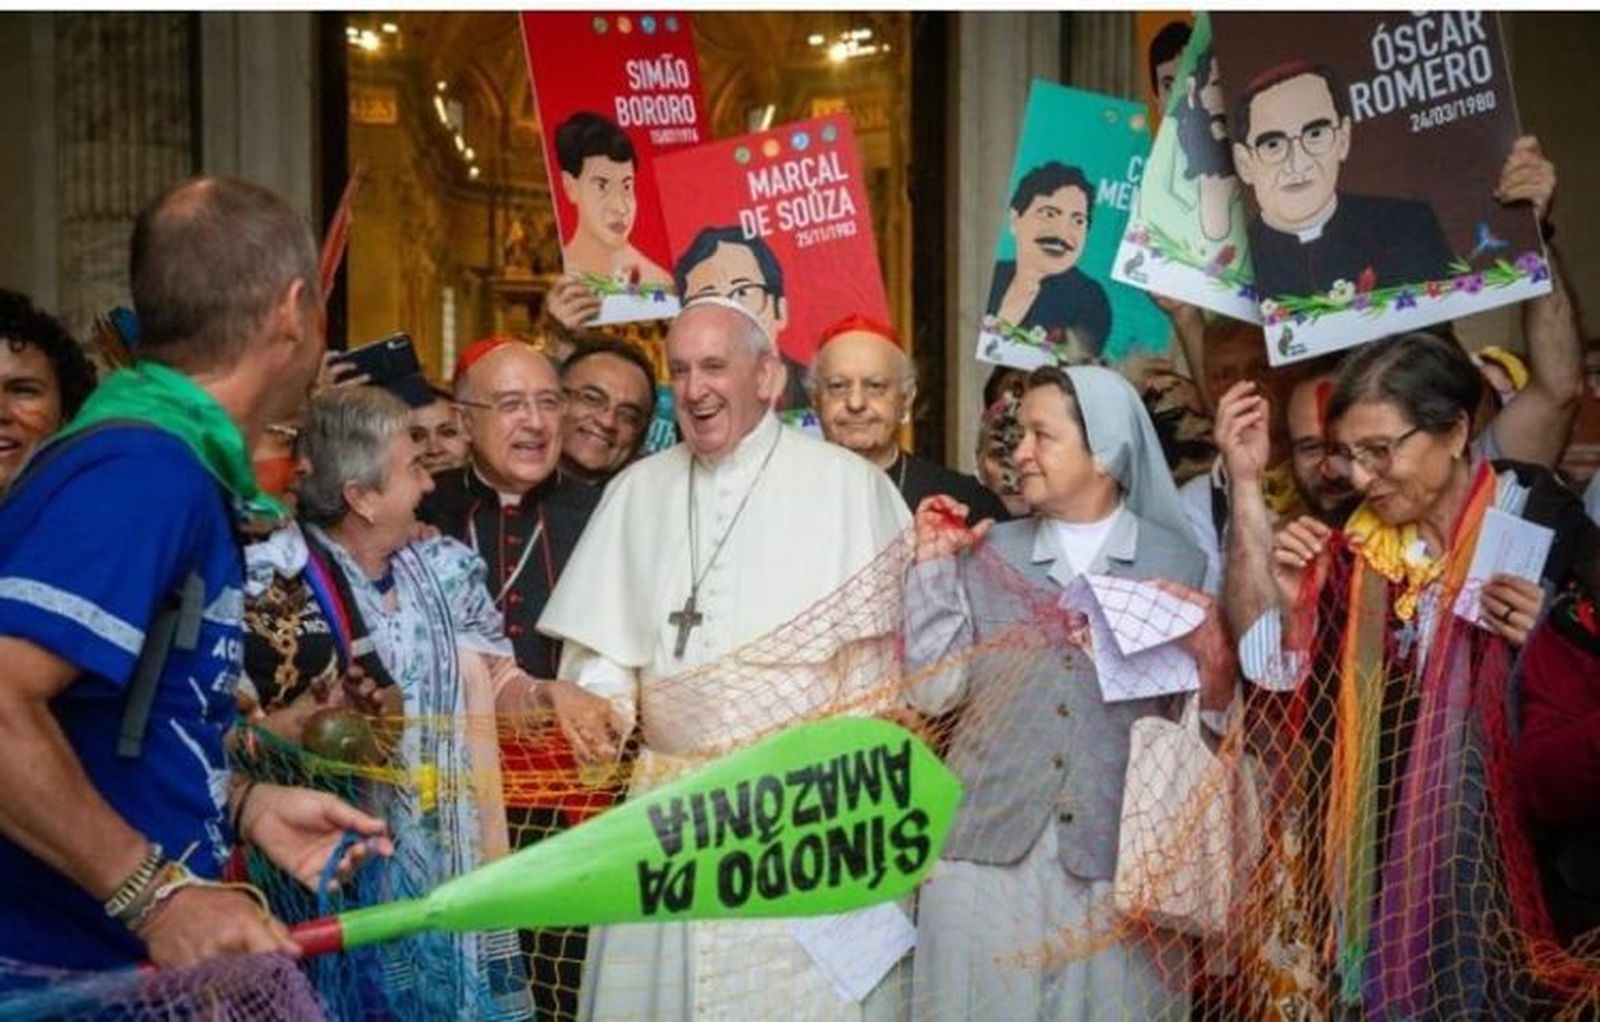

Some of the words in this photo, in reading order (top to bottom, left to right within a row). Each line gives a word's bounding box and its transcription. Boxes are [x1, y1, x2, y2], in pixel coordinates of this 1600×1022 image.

[1371, 11, 1487, 71] ÓSCAR
[625, 53, 690, 91] SIMÃO
[1349, 44, 1493, 122] ROMERO
[615, 93, 697, 127] BORORO
[1410, 90, 1496, 132] 24/03/1980
[747, 151, 849, 202] MARÇAL
[1127, 155, 1143, 183] C
[1096, 178, 1136, 210] ME
[739, 205, 774, 240] DE
[648, 738, 912, 857] AMAZÔNIA
[717, 808, 931, 909] SÍNODO
[637, 858, 697, 916] DA
